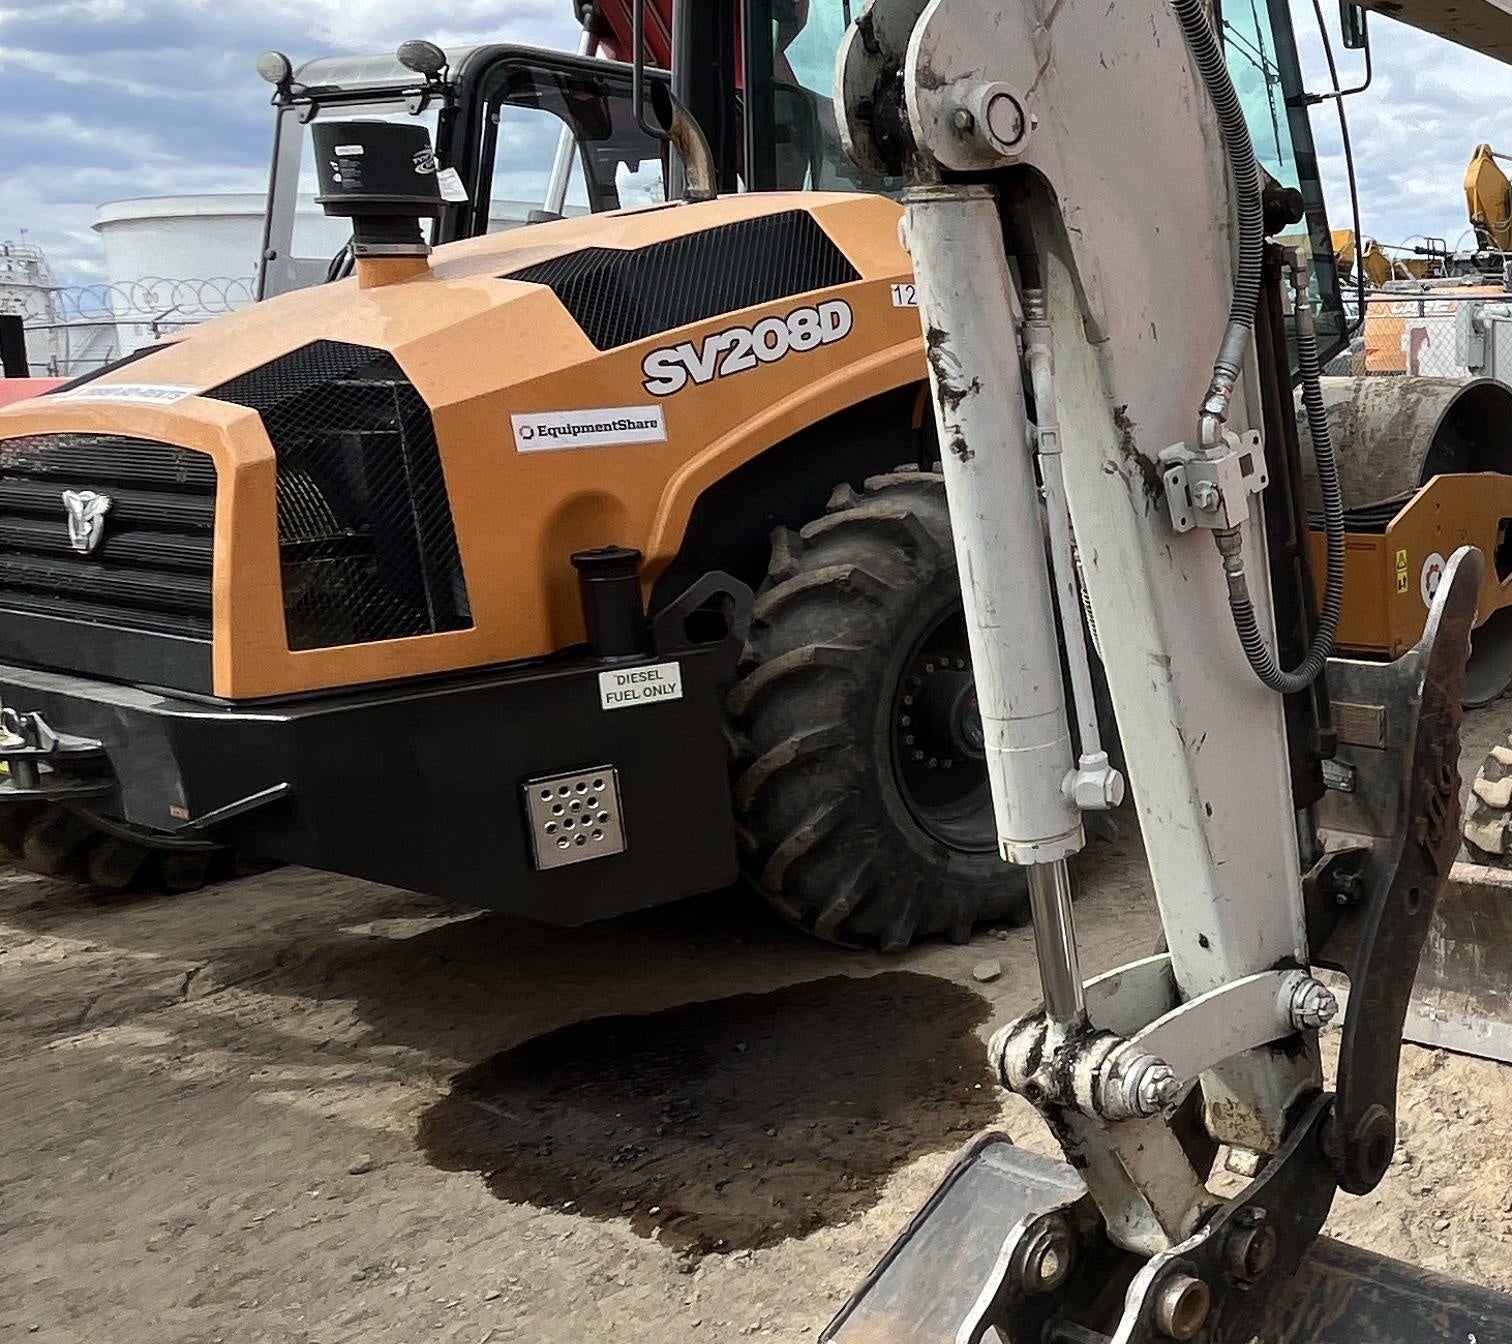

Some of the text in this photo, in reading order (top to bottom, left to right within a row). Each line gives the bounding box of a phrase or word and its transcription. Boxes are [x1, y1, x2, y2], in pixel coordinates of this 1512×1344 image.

[641, 299, 853, 397] SV208D
[537, 419, 658, 438] EquipmentShare
[617, 669, 663, 685] DIESEL
[606, 683, 676, 703] FUEL ONLY
